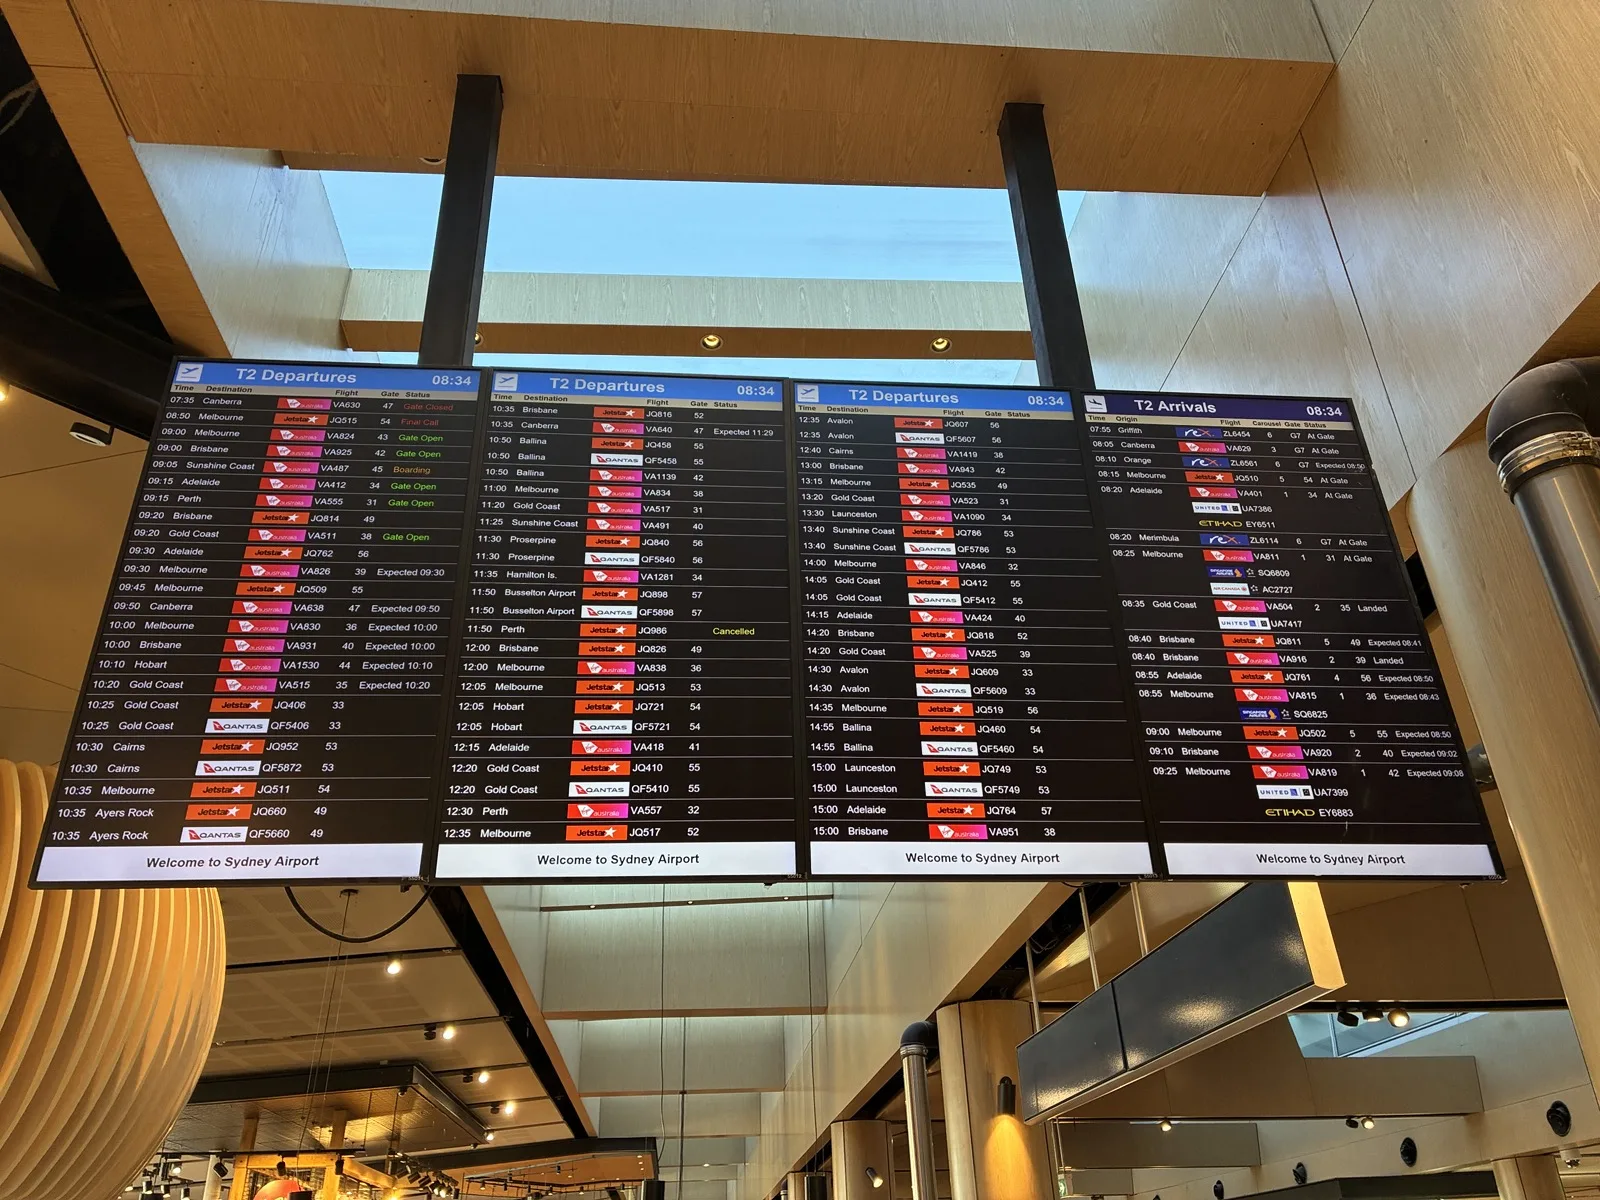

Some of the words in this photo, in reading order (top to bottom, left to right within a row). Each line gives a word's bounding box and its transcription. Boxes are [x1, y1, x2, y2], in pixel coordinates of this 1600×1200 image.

[237, 369, 256, 379] T2
[262, 370, 356, 383] Departures
[432, 375, 471, 385] 08:34
[206, 384, 252, 392] Destination
[550, 378, 569, 389] T2
[575, 379, 664, 393] Departures
[737, 386, 774, 395] 08:34
[849, 390, 867, 400] T2
[873, 391, 958, 404] Departures
[1028, 396, 1064, 405] 08:34
[1134, 400, 1153, 410] T2
[1158, 401, 1216, 413] Arrivals
[1307, 406, 1342, 416] 08:34
[714, 428, 749, 436] Expected
[394, 466, 430, 474] Boarding
[377, 569, 418, 577] Expected
[501, 625, 525, 633] Perth
[99, 660, 125, 668] 10:10
[283, 661, 319, 669] VA1530
[362, 662, 405, 671] Expected
[459, 702, 484, 710] 12:05
[842, 704, 887, 712] Melbourne
[975, 706, 1003, 714] JQ519
[1178, 728, 1222, 736] Melbourne
[1299, 729, 1326, 737] JQ502
[1377, 730, 1388, 738] 55
[1395, 731, 1429, 739] Expected
[449, 785, 475, 794] 12:20
[485, 785, 507, 794] Gold
[510, 785, 538, 794] Coast
[632, 785, 669, 793] QF5410
[688, 784, 700, 792] 55
[812, 784, 837, 792] 15:00
[846, 784, 897, 792] Launceston
[984, 786, 1020, 794] QF5749
[1039, 786, 1050, 794] 53
[59, 809, 86, 817] 10:35
[95, 809, 125, 819] Ayers
[128, 808, 154, 817] Rock
[253, 807, 287, 816] JQ660
[314, 807, 327, 815] 49
[1319, 809, 1353, 817] EY6883
[444, 829, 471, 838] 12:35
[480, 829, 531, 837] Melbourne
[629, 828, 661, 836] JQ517
[688, 827, 699, 836] 52
[814, 827, 839, 835] 15:00
[848, 827, 888, 835] Brisbane
[989, 828, 1018, 836] VA951
[1044, 828, 1056, 836] 38
[147, 858, 204, 867] Welcome
[209, 858, 221, 867] to
[225, 857, 271, 869] Sydney
[275, 856, 319, 868] Airport
[538, 855, 591, 864] Welcome
[596, 856, 607, 864] to
[611, 855, 654, 866] Sydney
[658, 854, 699, 865] Airport
[906, 853, 957, 862] Welcome
[961, 854, 972, 862] to
[976, 853, 1017, 864] Sydney
[1021, 854, 1060, 864] Airport
[1256, 854, 1307, 863] Welcome
[1310, 855, 1321, 863] to
[1324, 854, 1363, 865] Sydney
[1368, 855, 1405, 866] Airport
